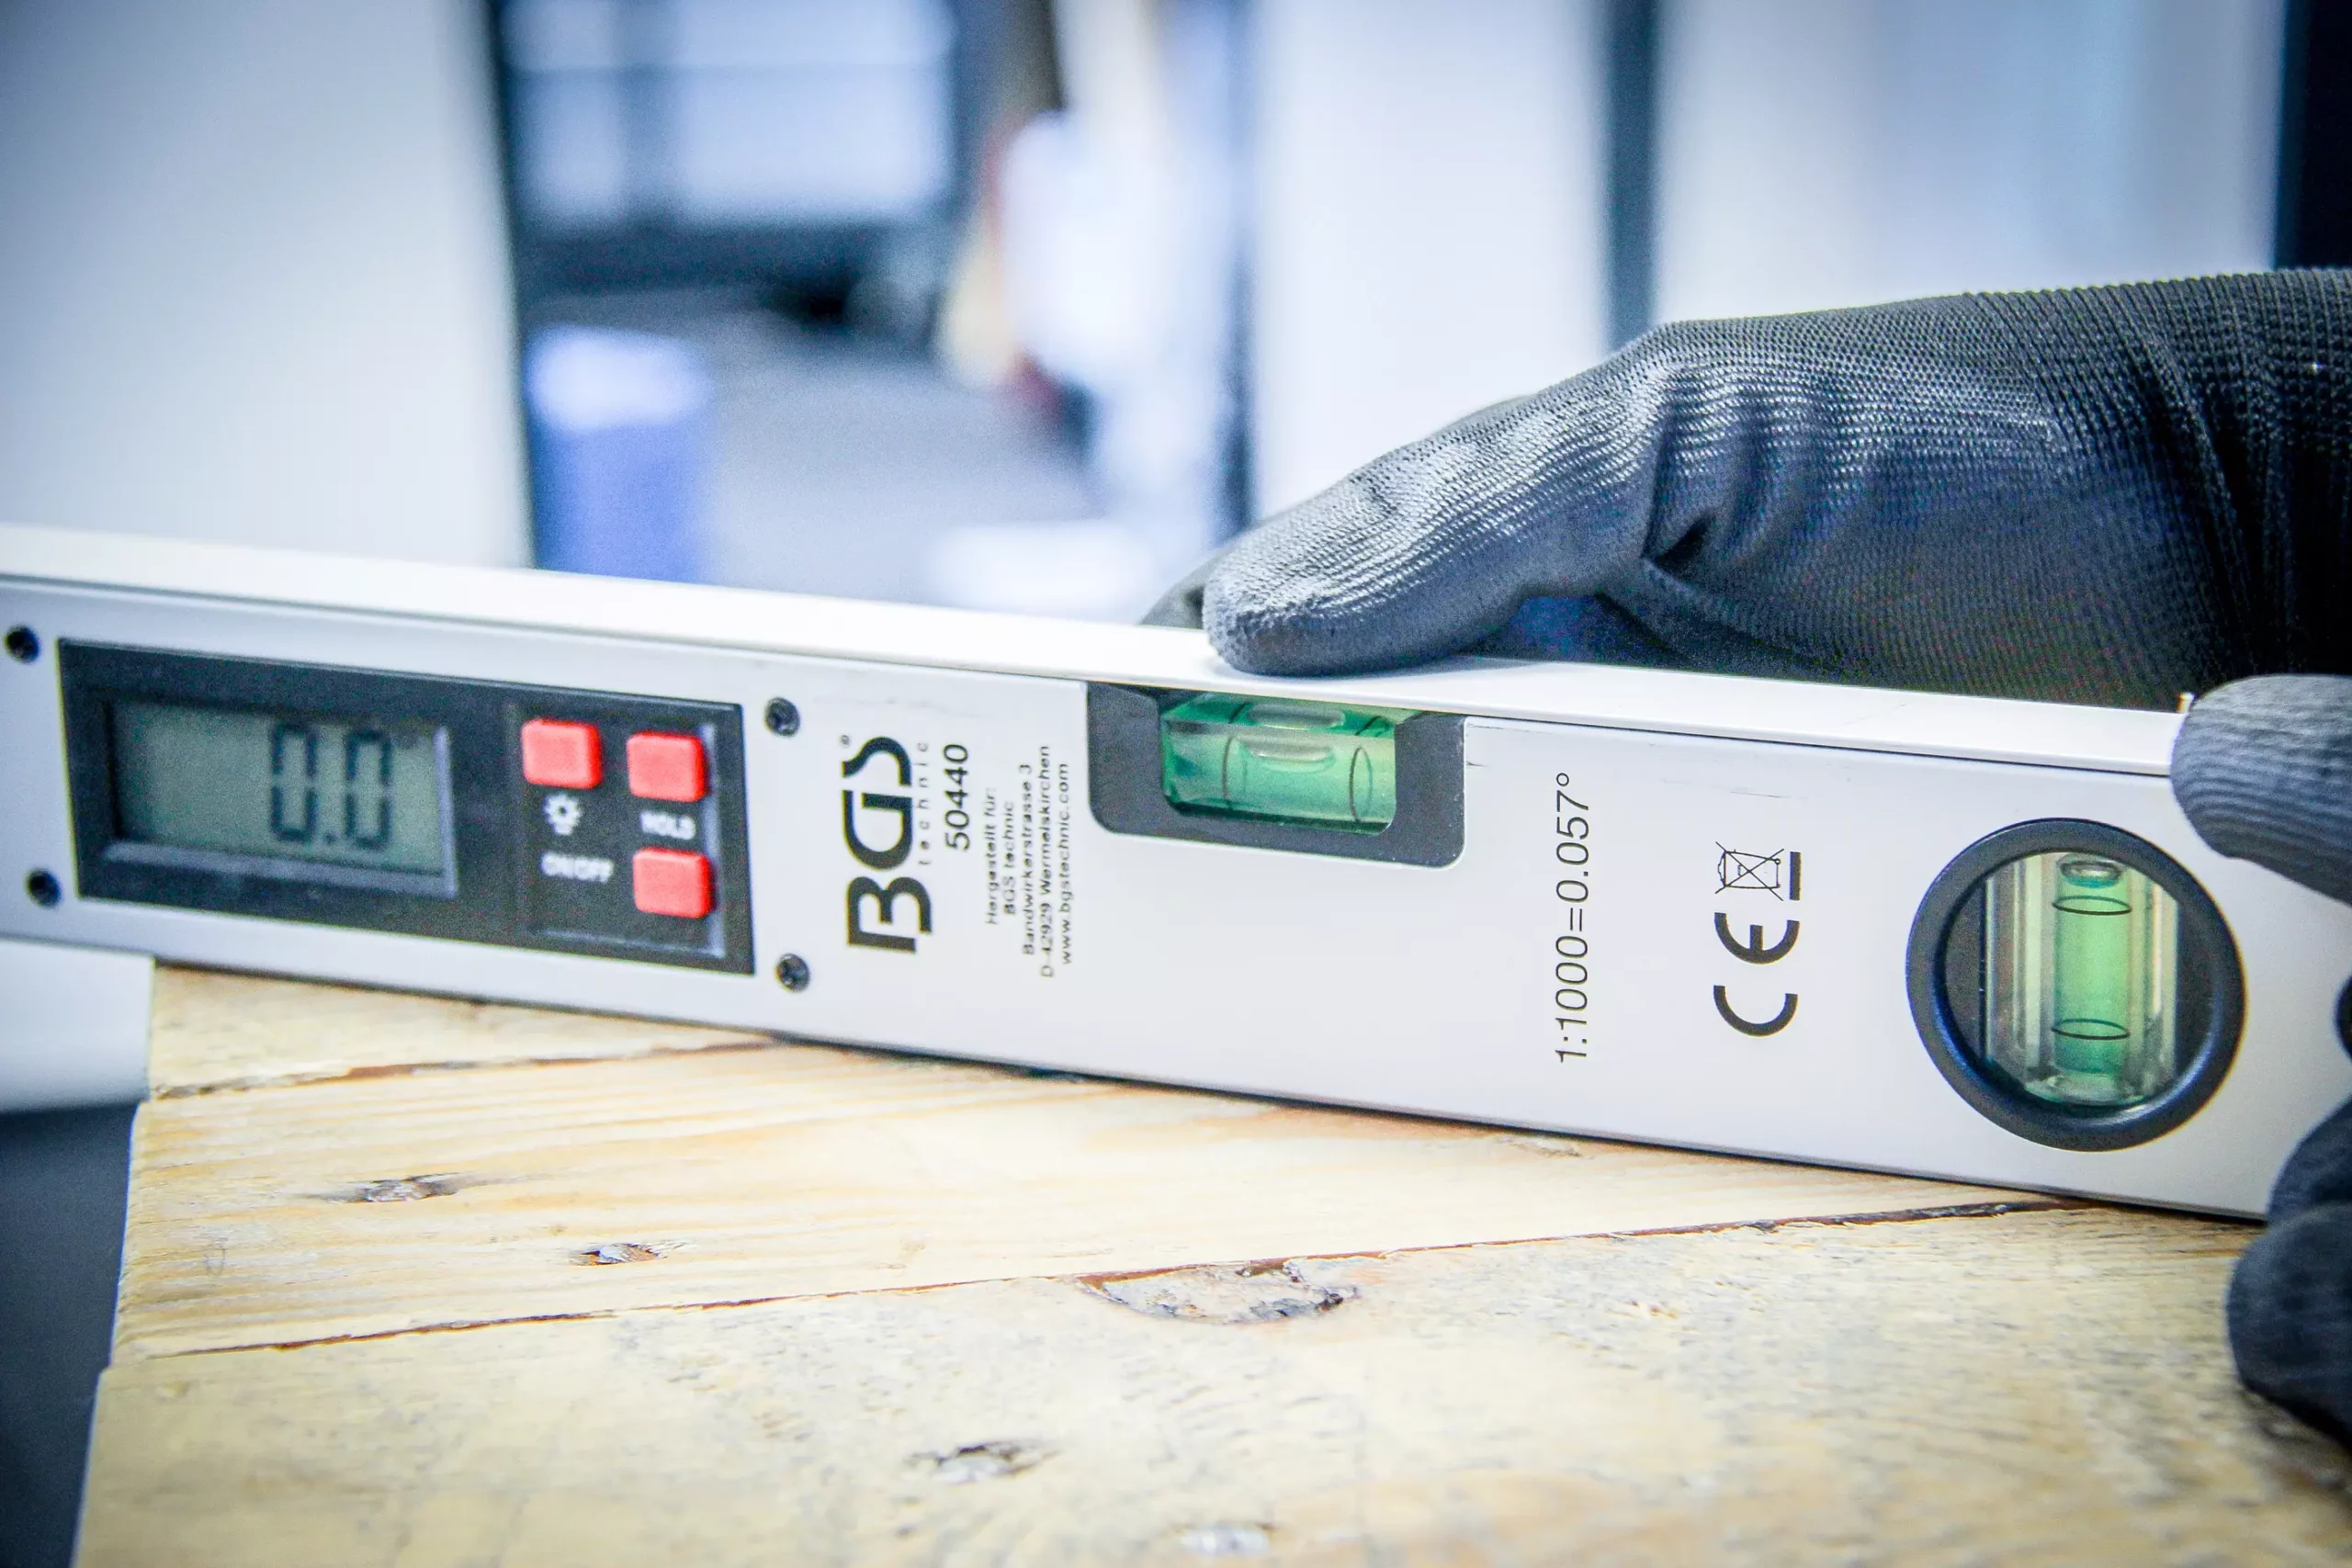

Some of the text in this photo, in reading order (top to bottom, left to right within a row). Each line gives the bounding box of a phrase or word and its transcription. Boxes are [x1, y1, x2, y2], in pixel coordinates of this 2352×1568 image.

[270, 722, 392, 850] 0.0
[841, 737, 933, 954] BGS
[915, 742, 931, 866] technic
[943, 744, 970, 851] 50440
[1038, 746, 1052, 895] Wermelskirchen
[984, 824, 1000, 925] Hergestellt
[1002, 802, 1015, 916] BGS technic
[1019, 763, 1035, 955] Bandwirkerstrasse 3
[1057, 763, 1073, 964] www.bgstechnic.com
[1555, 773, 1589, 1065] 1:1000=0.057°
